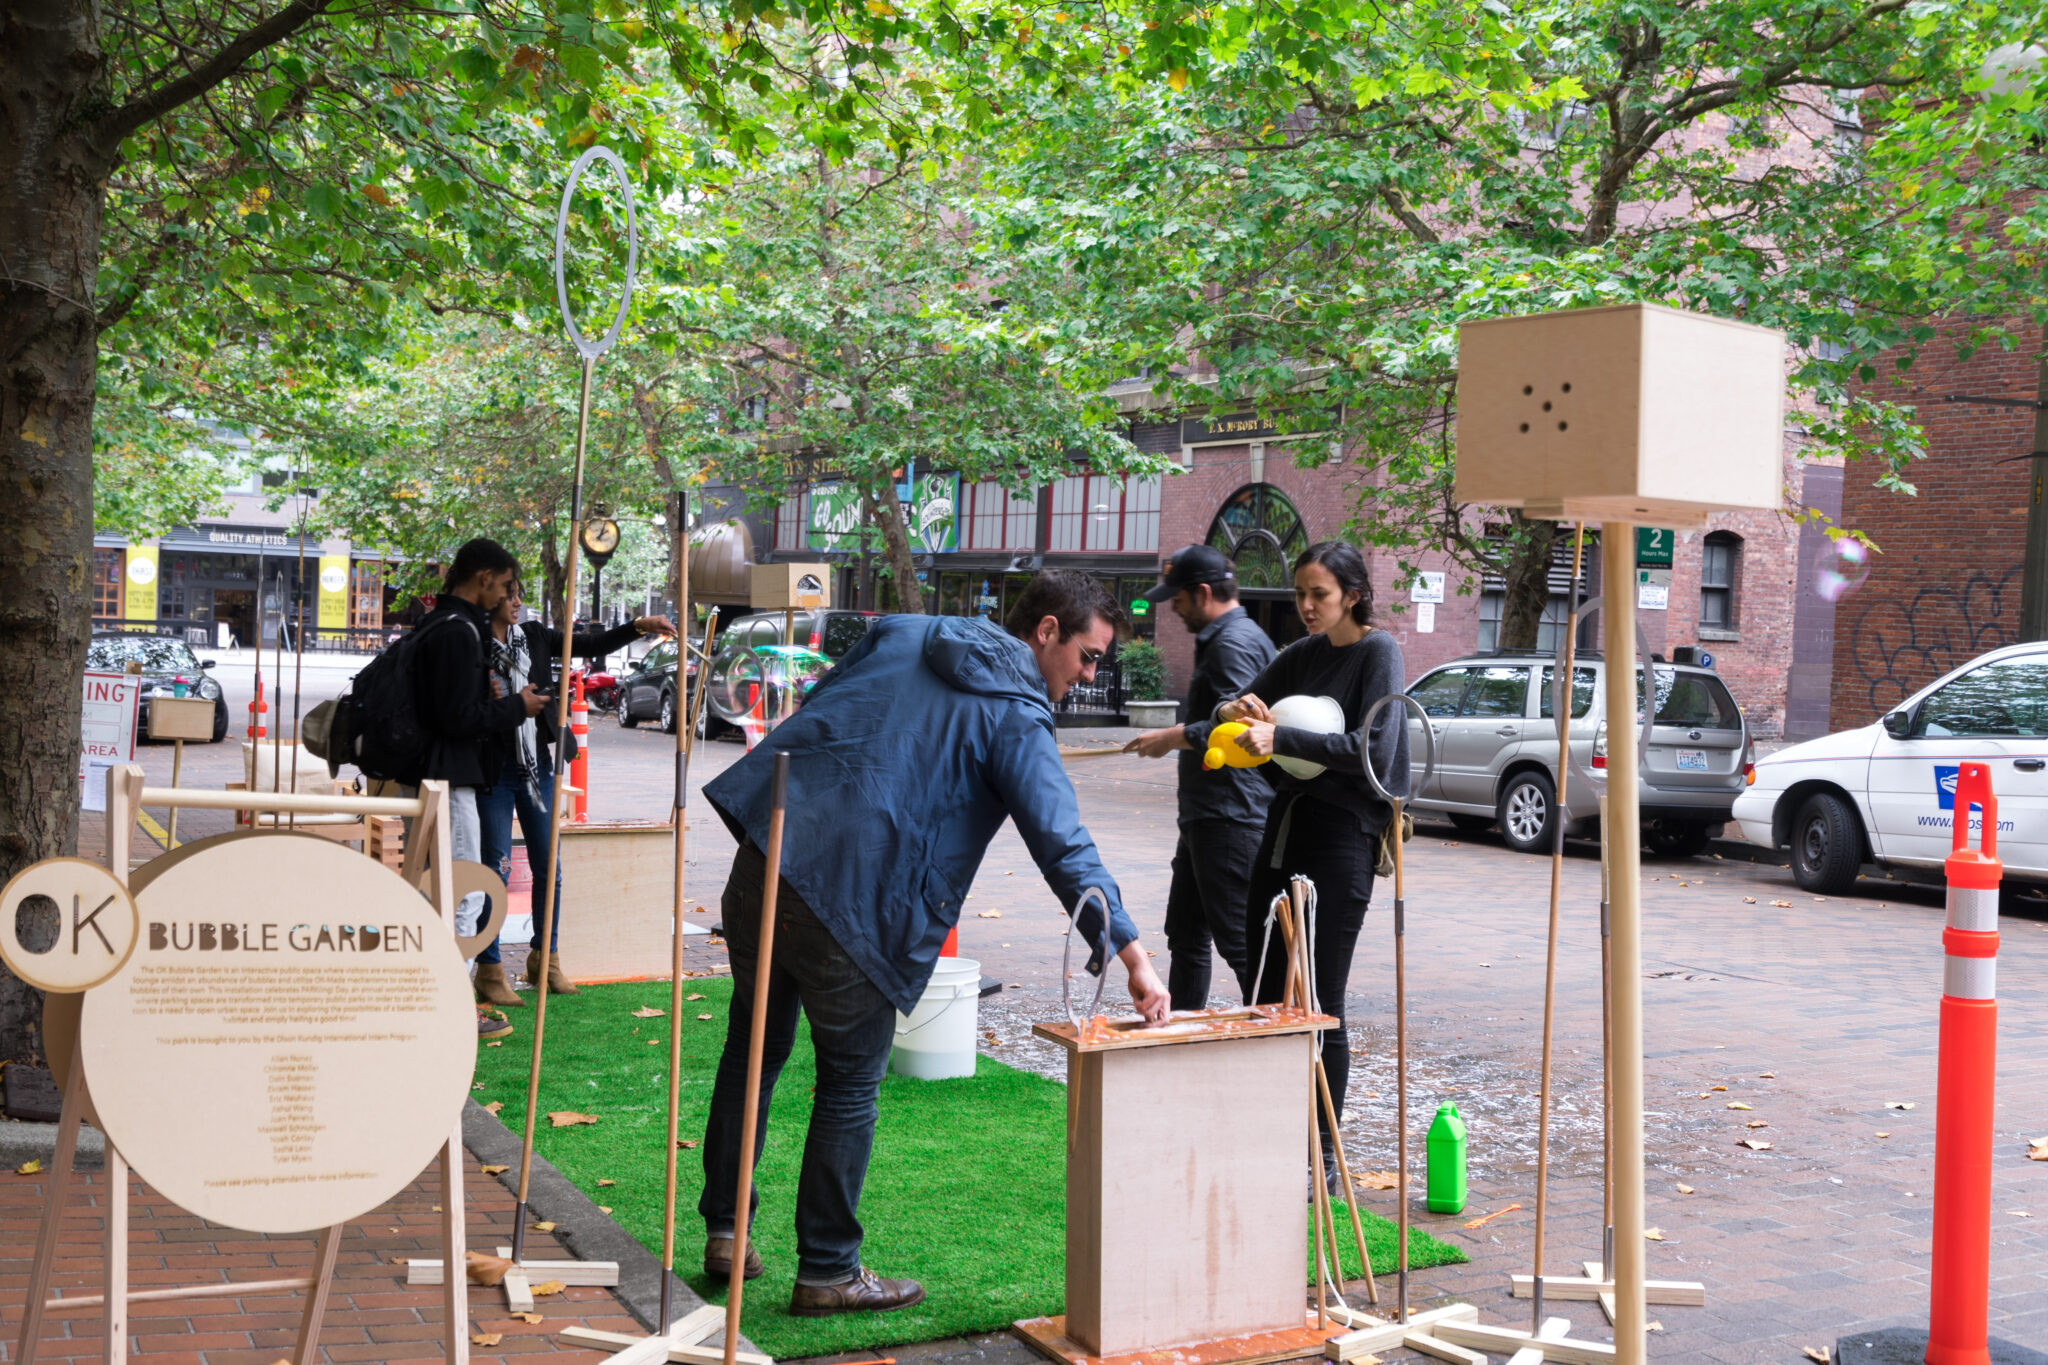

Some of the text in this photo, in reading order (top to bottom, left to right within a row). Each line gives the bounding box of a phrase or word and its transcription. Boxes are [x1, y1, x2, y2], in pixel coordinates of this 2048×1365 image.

[815, 499, 831, 528] GO
[209, 532, 244, 543] QUALITY
[1650, 528, 1662, 548] 2
[14, 893, 116, 955] OK
[148, 922, 424, 952] BUBBLE GARDEN
